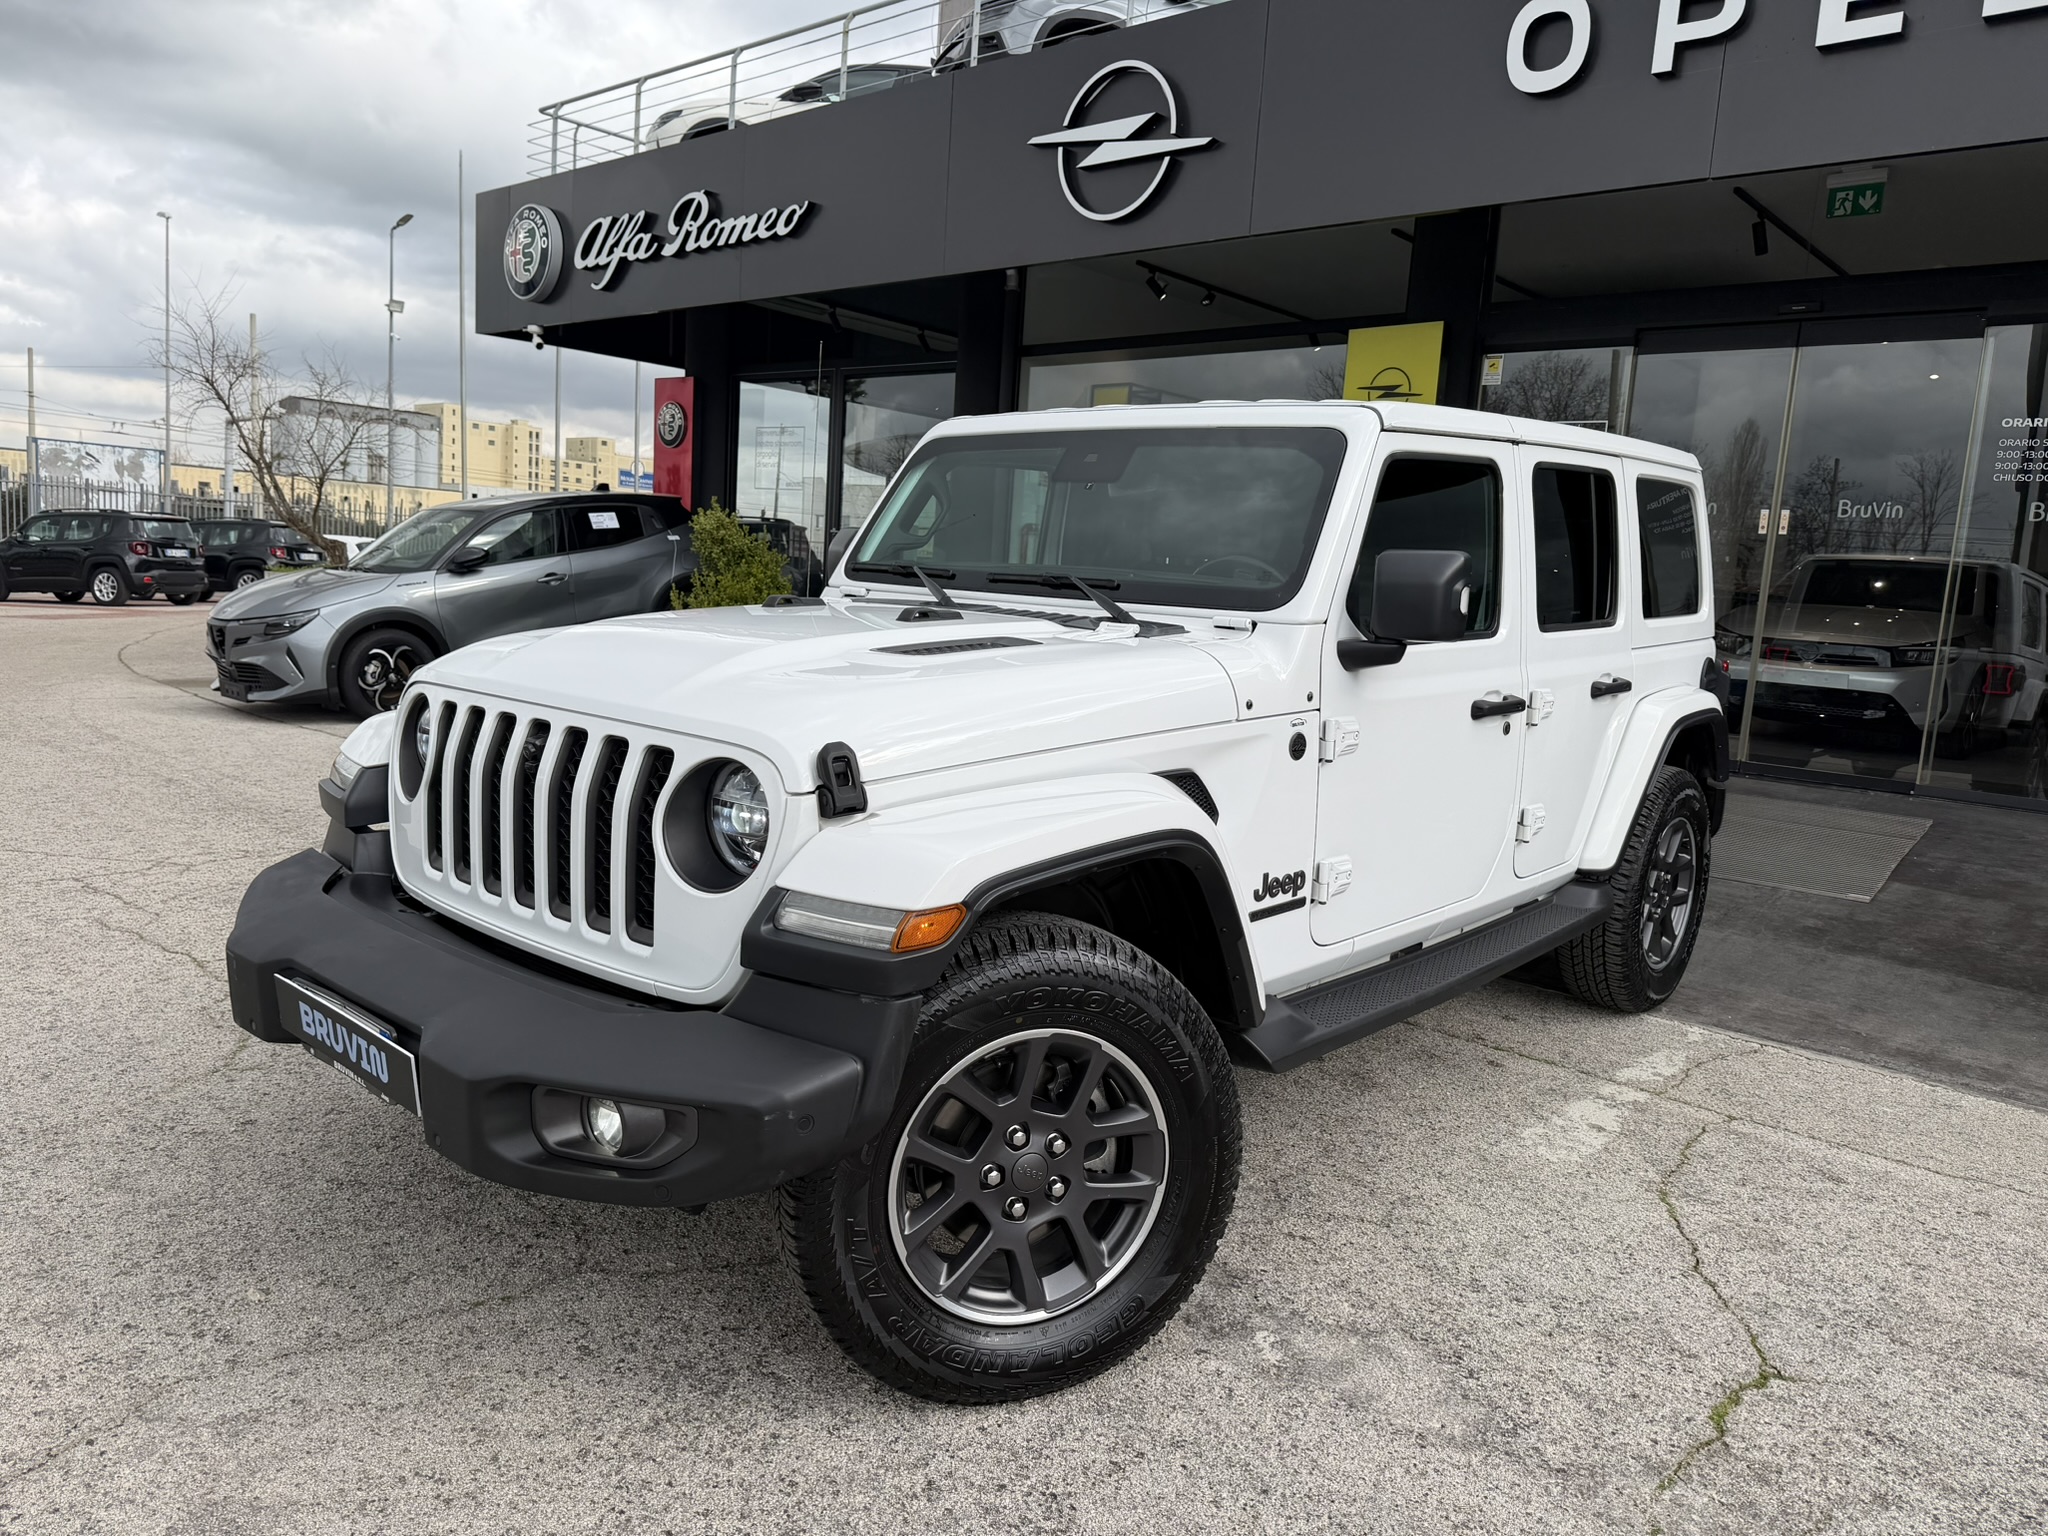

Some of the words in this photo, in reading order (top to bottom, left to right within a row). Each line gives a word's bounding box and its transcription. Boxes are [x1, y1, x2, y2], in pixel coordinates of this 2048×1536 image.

[522, 209, 548, 249] ROMEO
[573, 209, 658, 291] Alfa
[660, 190, 809, 258] Romeo
[1998, 438, 2041, 447] ORARIO
[1993, 473, 2033, 482] CHIUSO
[1836, 499, 1904, 519] BruVin
[2028, 501, 2048, 522] B
[1253, 869, 1306, 902] Jeep
[298, 1000, 389, 1084] BRUVIN
[995, 985, 1195, 1084] YOKOHAMA
[887, 1294, 1145, 1374] GEOLANDAR
